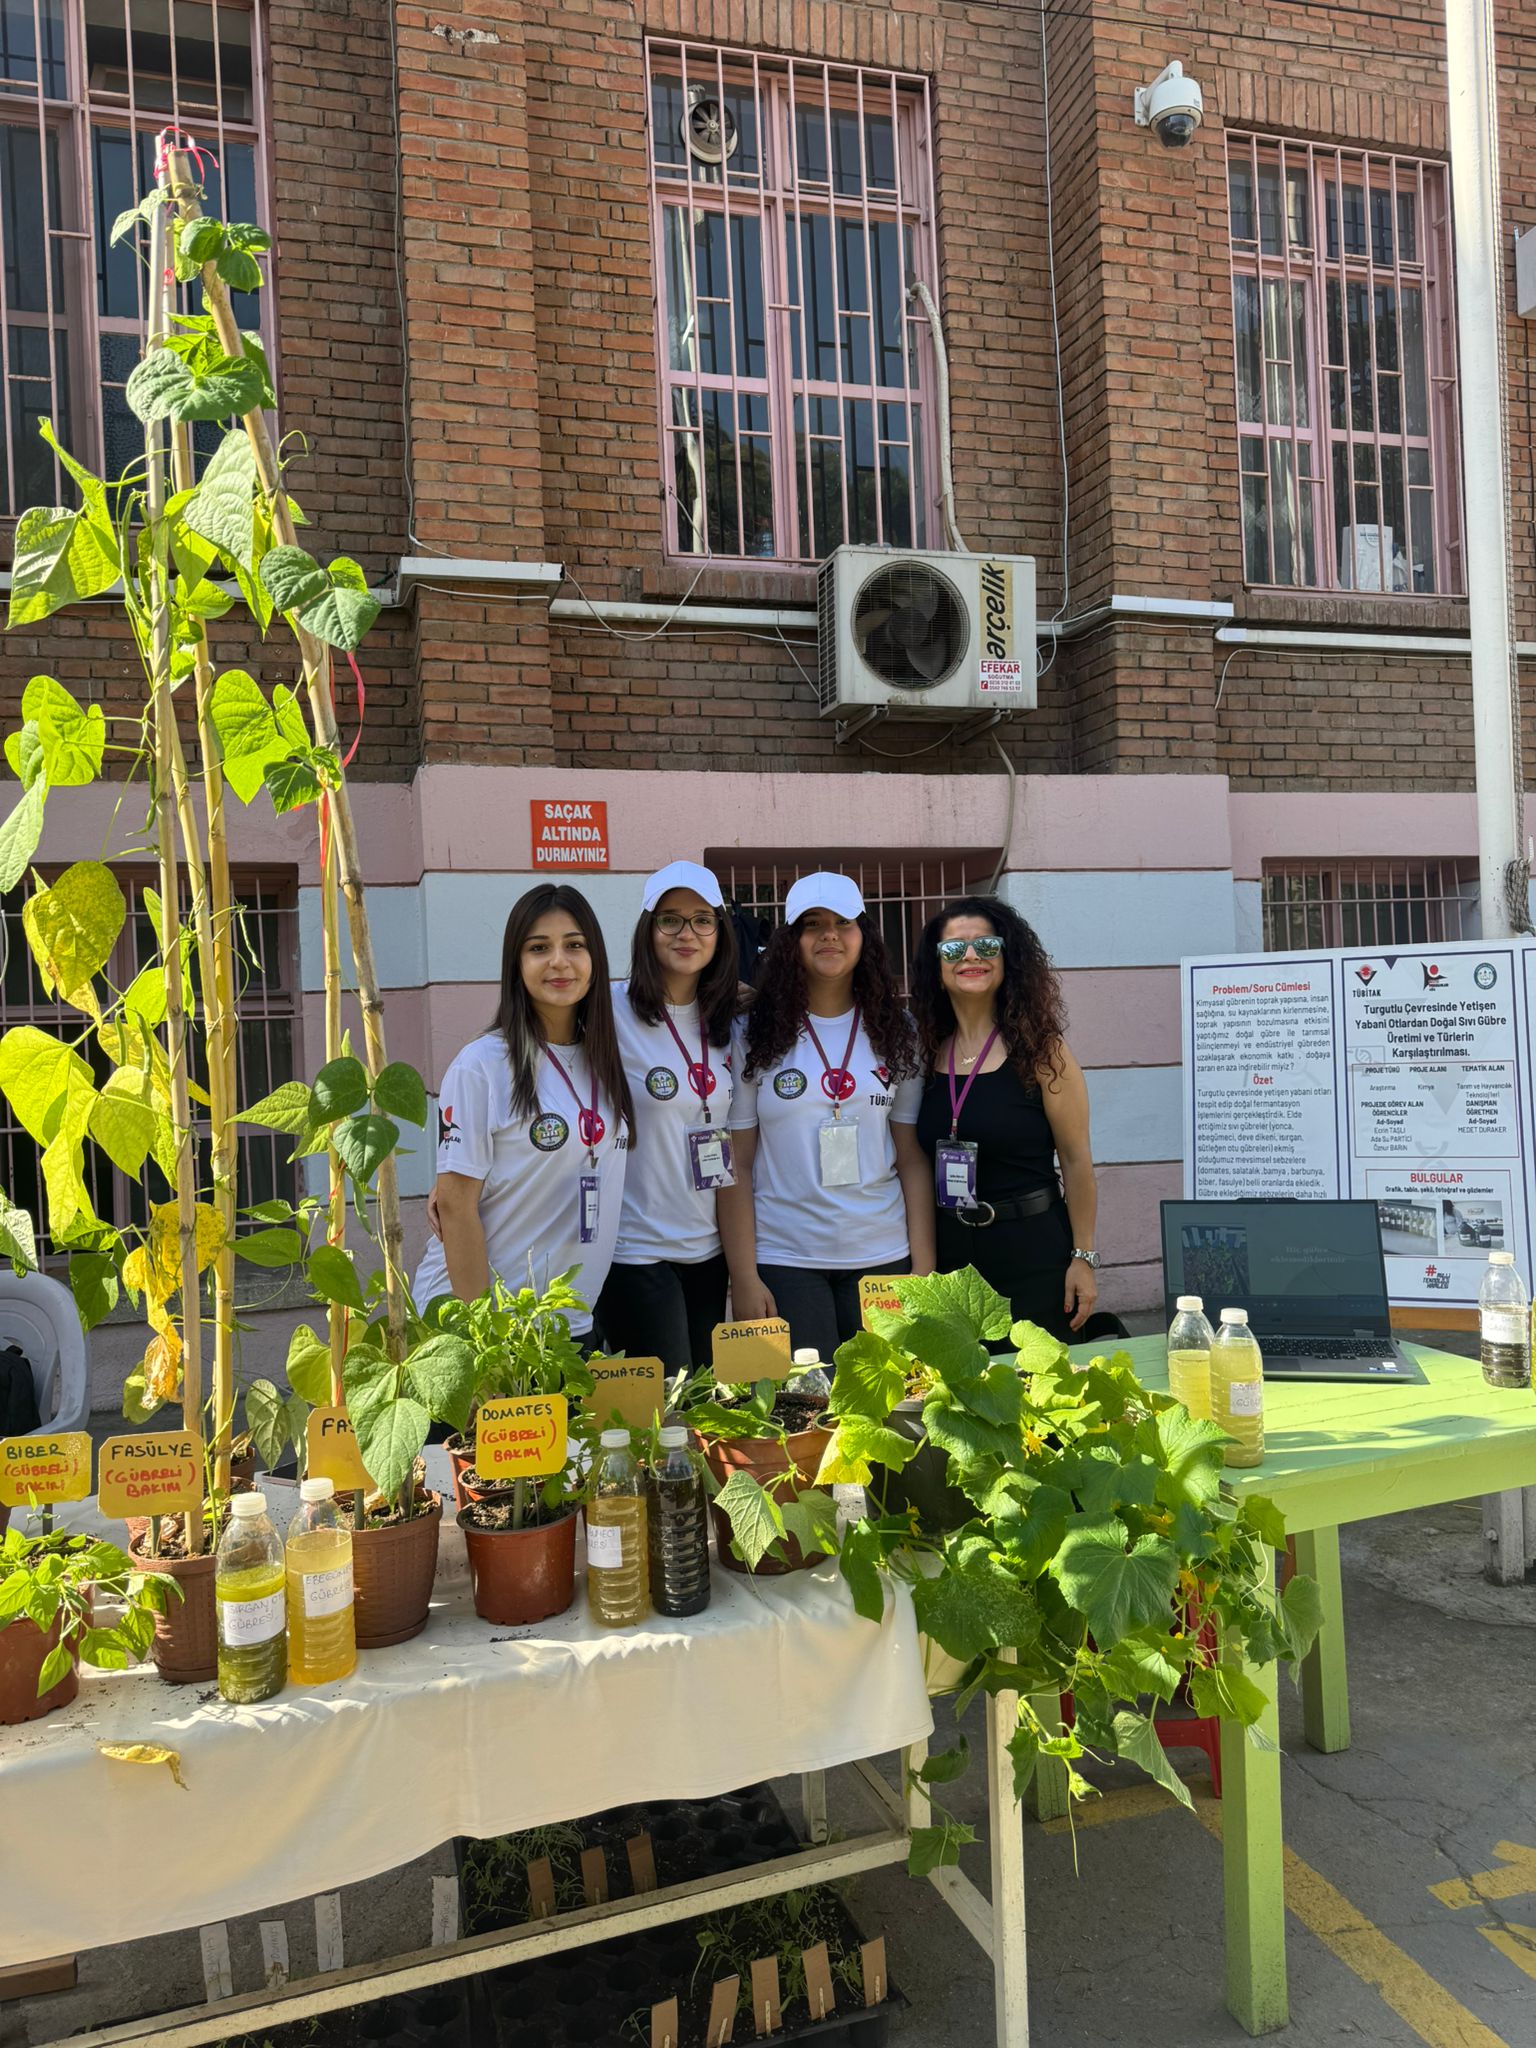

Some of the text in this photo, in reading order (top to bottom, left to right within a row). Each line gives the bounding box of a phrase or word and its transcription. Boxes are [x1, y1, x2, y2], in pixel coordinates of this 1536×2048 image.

[982, 563, 1011, 659] arçelik
[981, 661, 1020, 673] EFEKAR
[544, 804, 592, 823] SAÇAK
[542, 826, 601, 841] ALTINDA
[536, 847, 607, 862] DURMAYINIZ
[1213, 982, 1310, 994] Problem/Soru Cümlesi
[1353, 989, 1381, 998] TÜBİTAK
[1196, 999, 1225, 1008] Kimyasal
[1226, 998, 1255, 1007] gübrenin
[1256, 996, 1278, 1006] toprak
[1238, 1008, 1281, 1018] kaynaklarının
[1364, 1001, 1496, 1016] Turgutlu Çevresinde Yetişen
[1223, 1020, 1251, 1028] yapısının
[1356, 1016, 1506, 1029] Yabani Otlardan Doğal Sıvı Gübre
[1260, 1030, 1280, 1038] gübre
[1388, 1032, 1422, 1043] Üretimi
[1437, 1031, 1474, 1042] Türlerin
[1197, 1042, 1240, 1050] bilinçlenmeyi
[1256, 1040, 1293, 1050] endüstriyel
[1197, 1053, 1235, 1062] uzaklaşarak
[1392, 1047, 1470, 1060] Karşılaştırılması.
[1272, 1062, 1289, 1072] miyiz
[1253, 1074, 1273, 1084] Özet
[1198, 1089, 1225, 1098] Turgutlu
[1226, 1089, 1262, 1098] çevresinde
[1264, 1089, 1289, 1098] yetişen
[1290, 1088, 1312, 1097] yabani
[1370, 1084, 1396, 1092] Araştırma
[1418, 1084, 1434, 1092] Kimya
[869, 1093, 895, 1106] TÜBİTA
[1198, 1100, 1300, 1109] tespit edip doğal fermantasyon
[1198, 1112, 1232, 1120] işlemlerini
[1198, 1123, 1227, 1131] ettiğimiz
[1240, 1123, 1268, 1131] gübreler
[1198, 1145, 1226, 1153] sütleğen
[1198, 1156, 1234, 1164] olduğumuz
[1410, 1173, 1463, 1183] BULGULAR
[719, 1324, 790, 1340] SALATALIK
[590, 1367, 655, 1380] DOMATES
[482, 1403, 552, 1421] DOMATES
[112, 1441, 193, 1460] FASÜLYE
[126, 1482, 181, 1498] BAKIM
